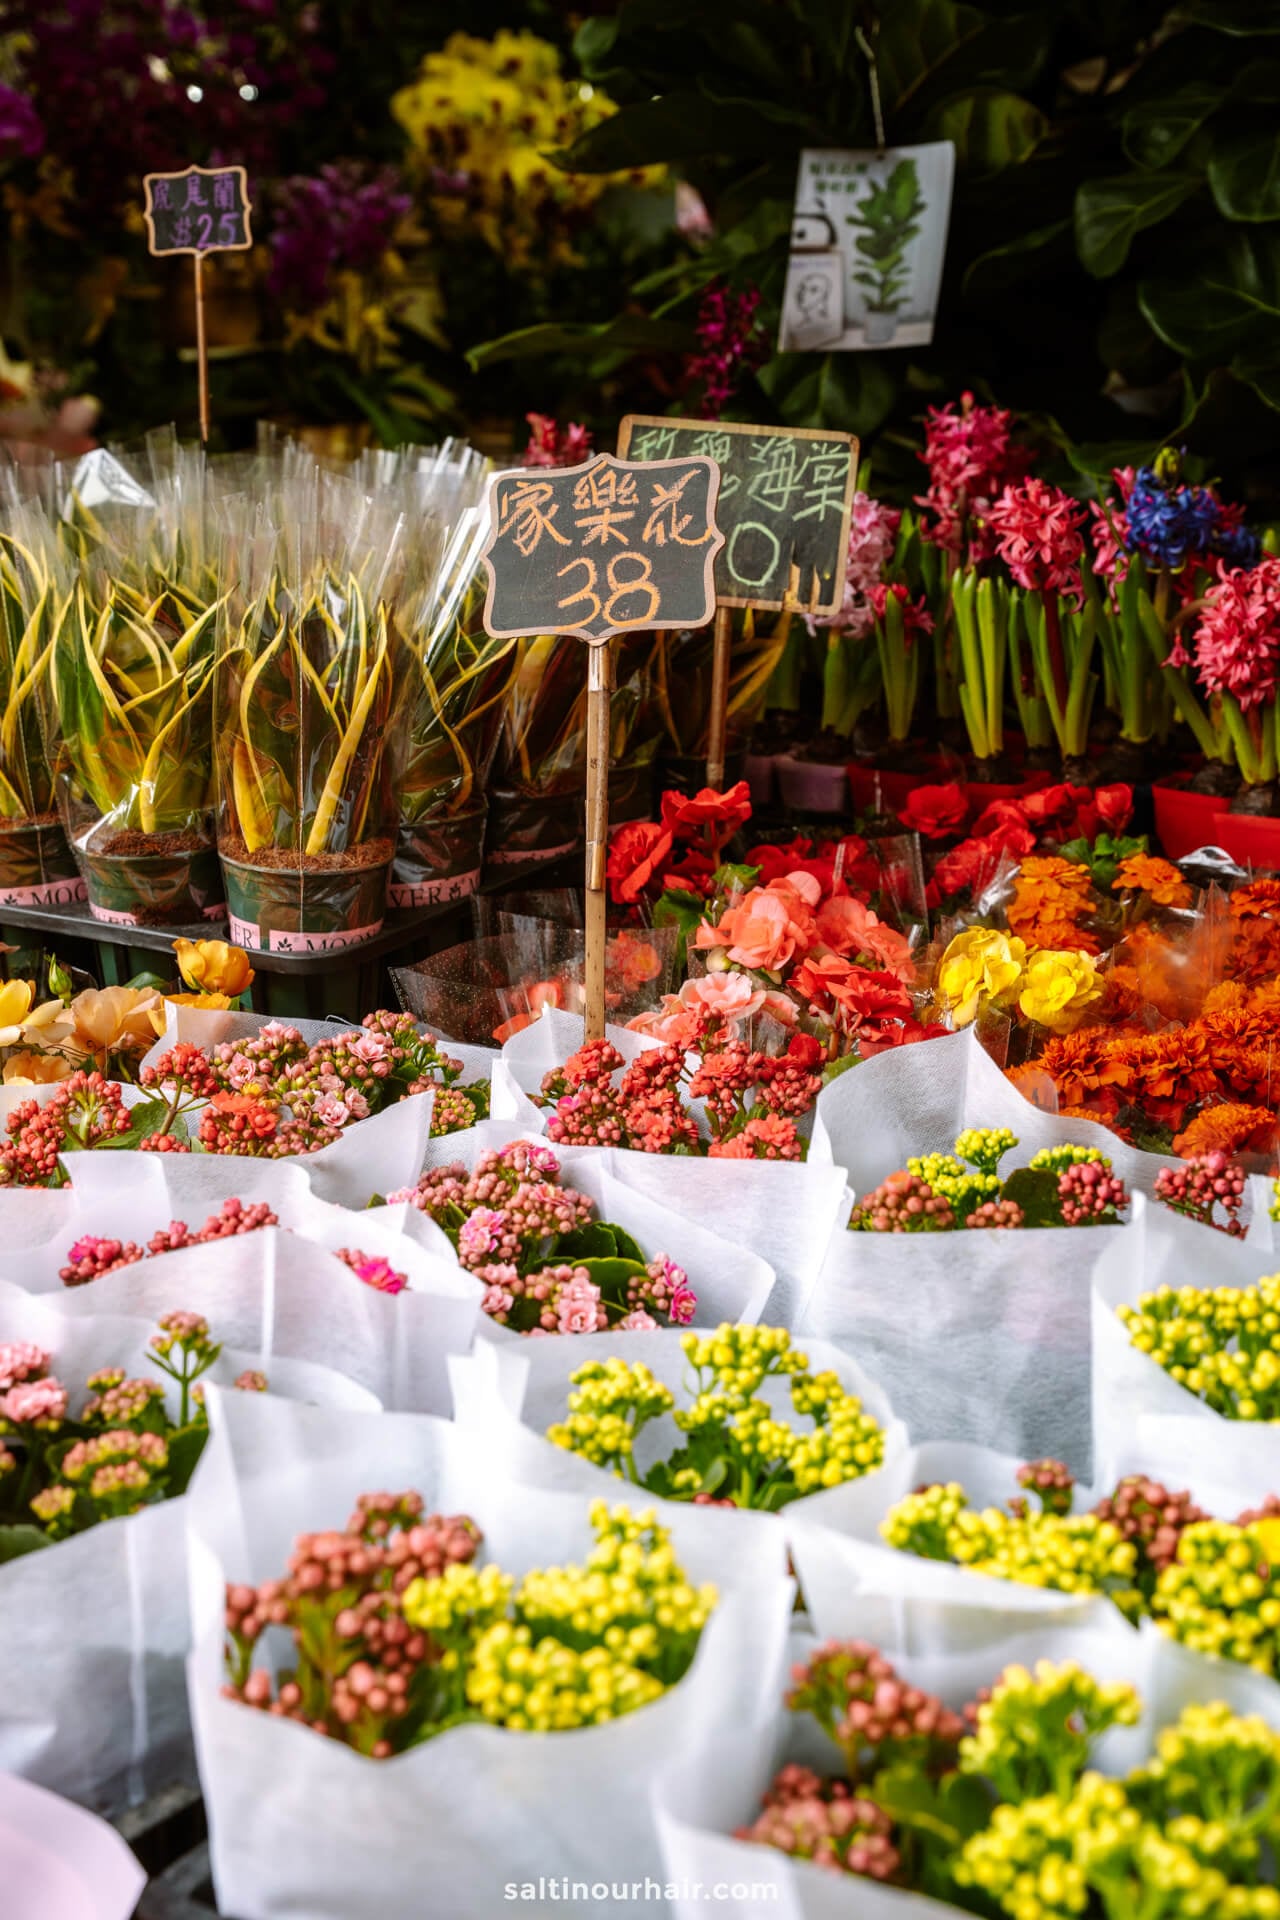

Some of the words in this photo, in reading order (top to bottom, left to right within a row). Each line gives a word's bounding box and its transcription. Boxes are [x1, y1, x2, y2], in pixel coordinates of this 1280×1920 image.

[170, 212, 241, 249] $25
[498, 459, 713, 556] 家樂花
[553, 551, 661, 633] 38
